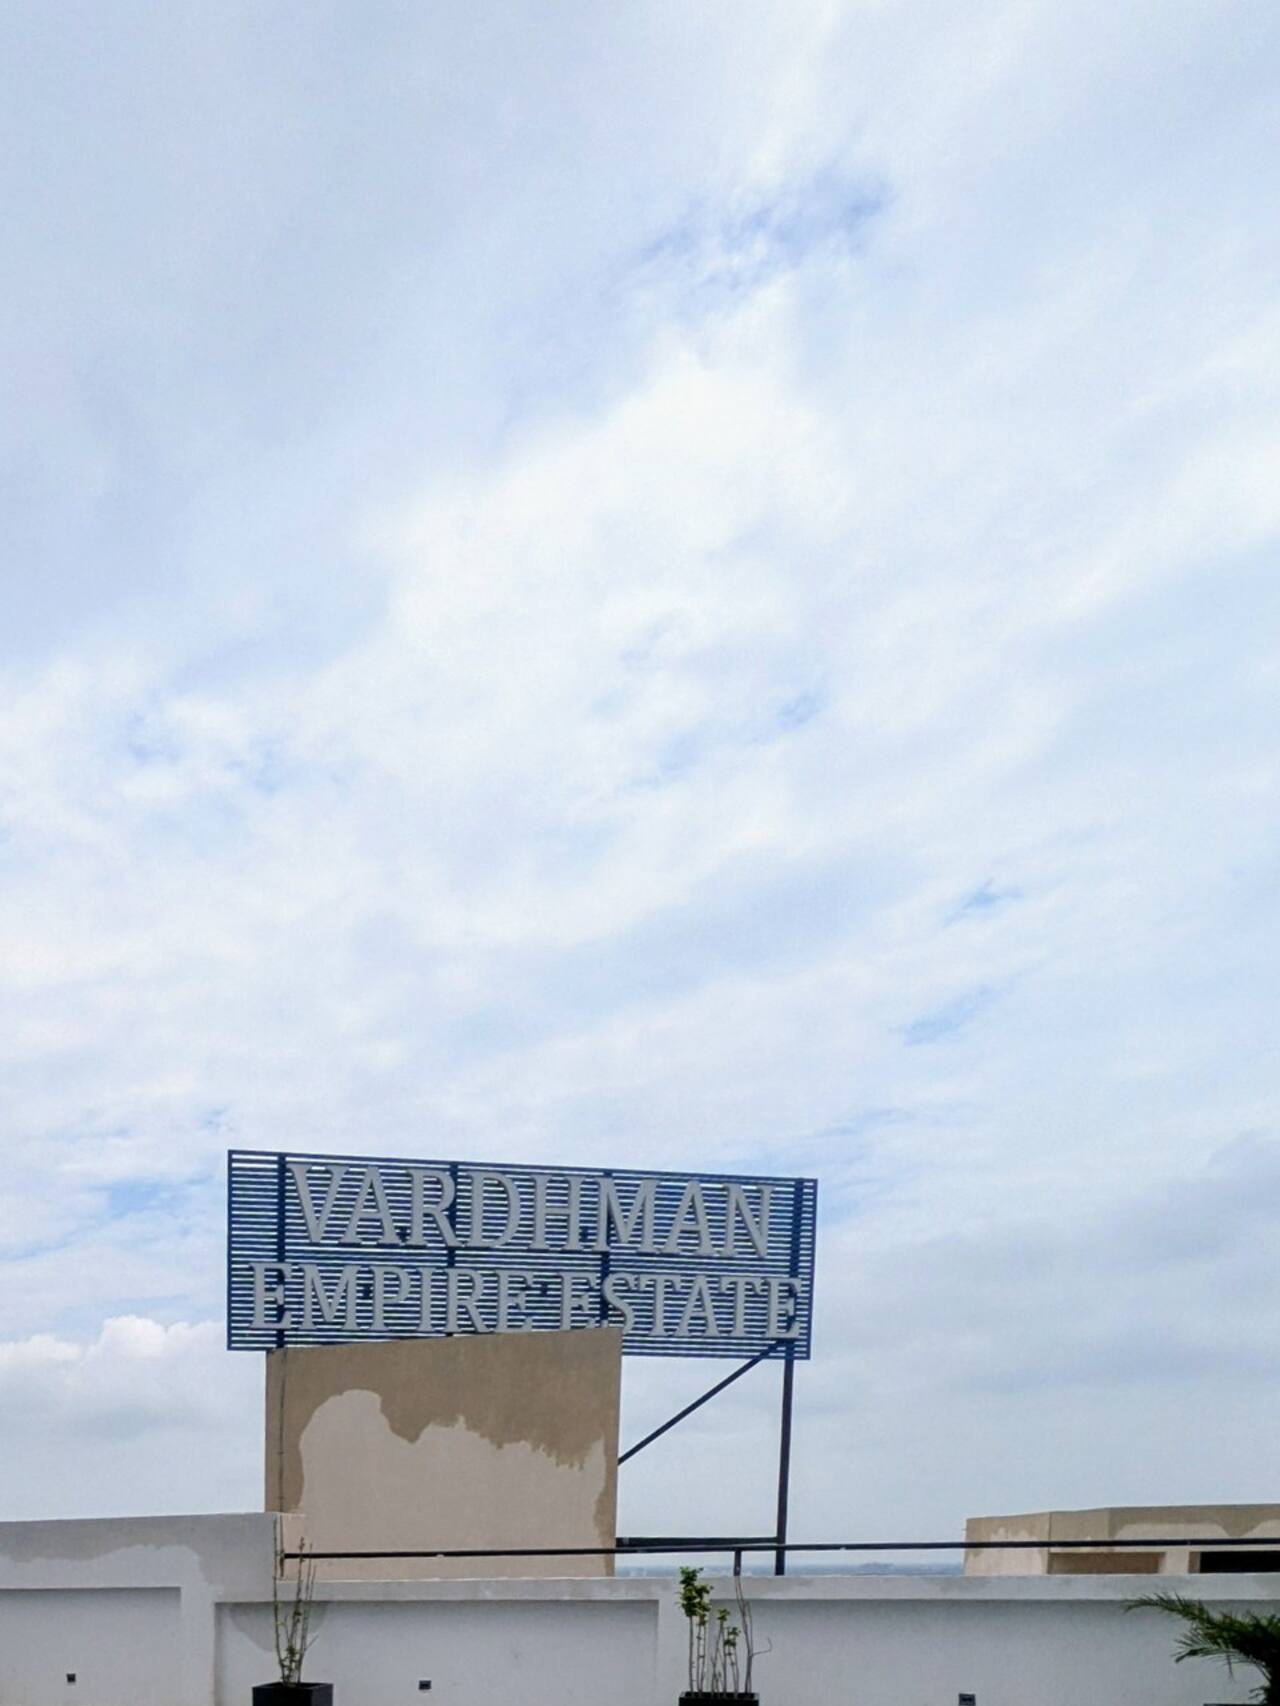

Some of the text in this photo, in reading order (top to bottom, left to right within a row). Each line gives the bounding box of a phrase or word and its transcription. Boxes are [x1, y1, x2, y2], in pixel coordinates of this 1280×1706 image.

[288, 1163, 774, 1258] VARDHMAN
[249, 1262, 802, 1338] EMPIRE ESTATE
